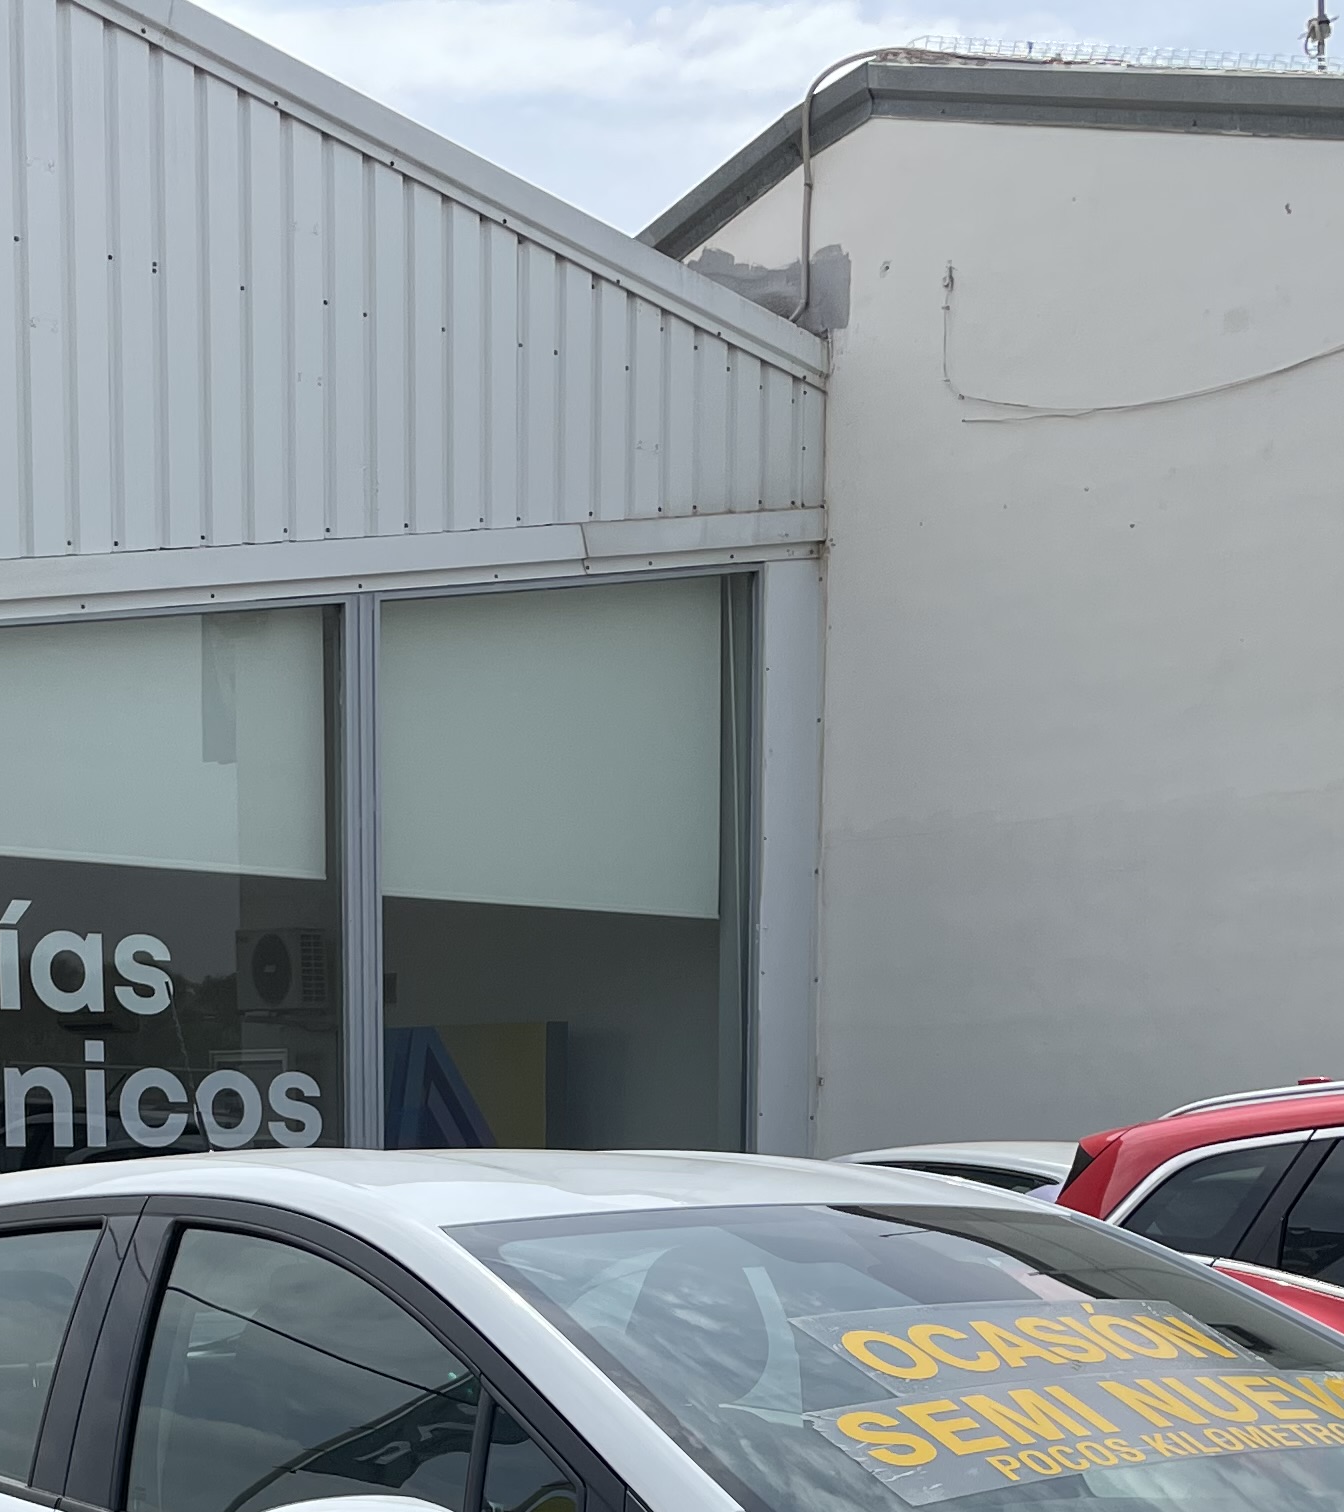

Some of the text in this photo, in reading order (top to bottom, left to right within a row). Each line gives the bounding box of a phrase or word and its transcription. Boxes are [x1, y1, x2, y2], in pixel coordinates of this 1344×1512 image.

[840, 1304, 1238, 1382] OCASIÓN
[836, 1382, 1118, 1468] SEMI
[984, 1440, 1148, 1482] POCOS
